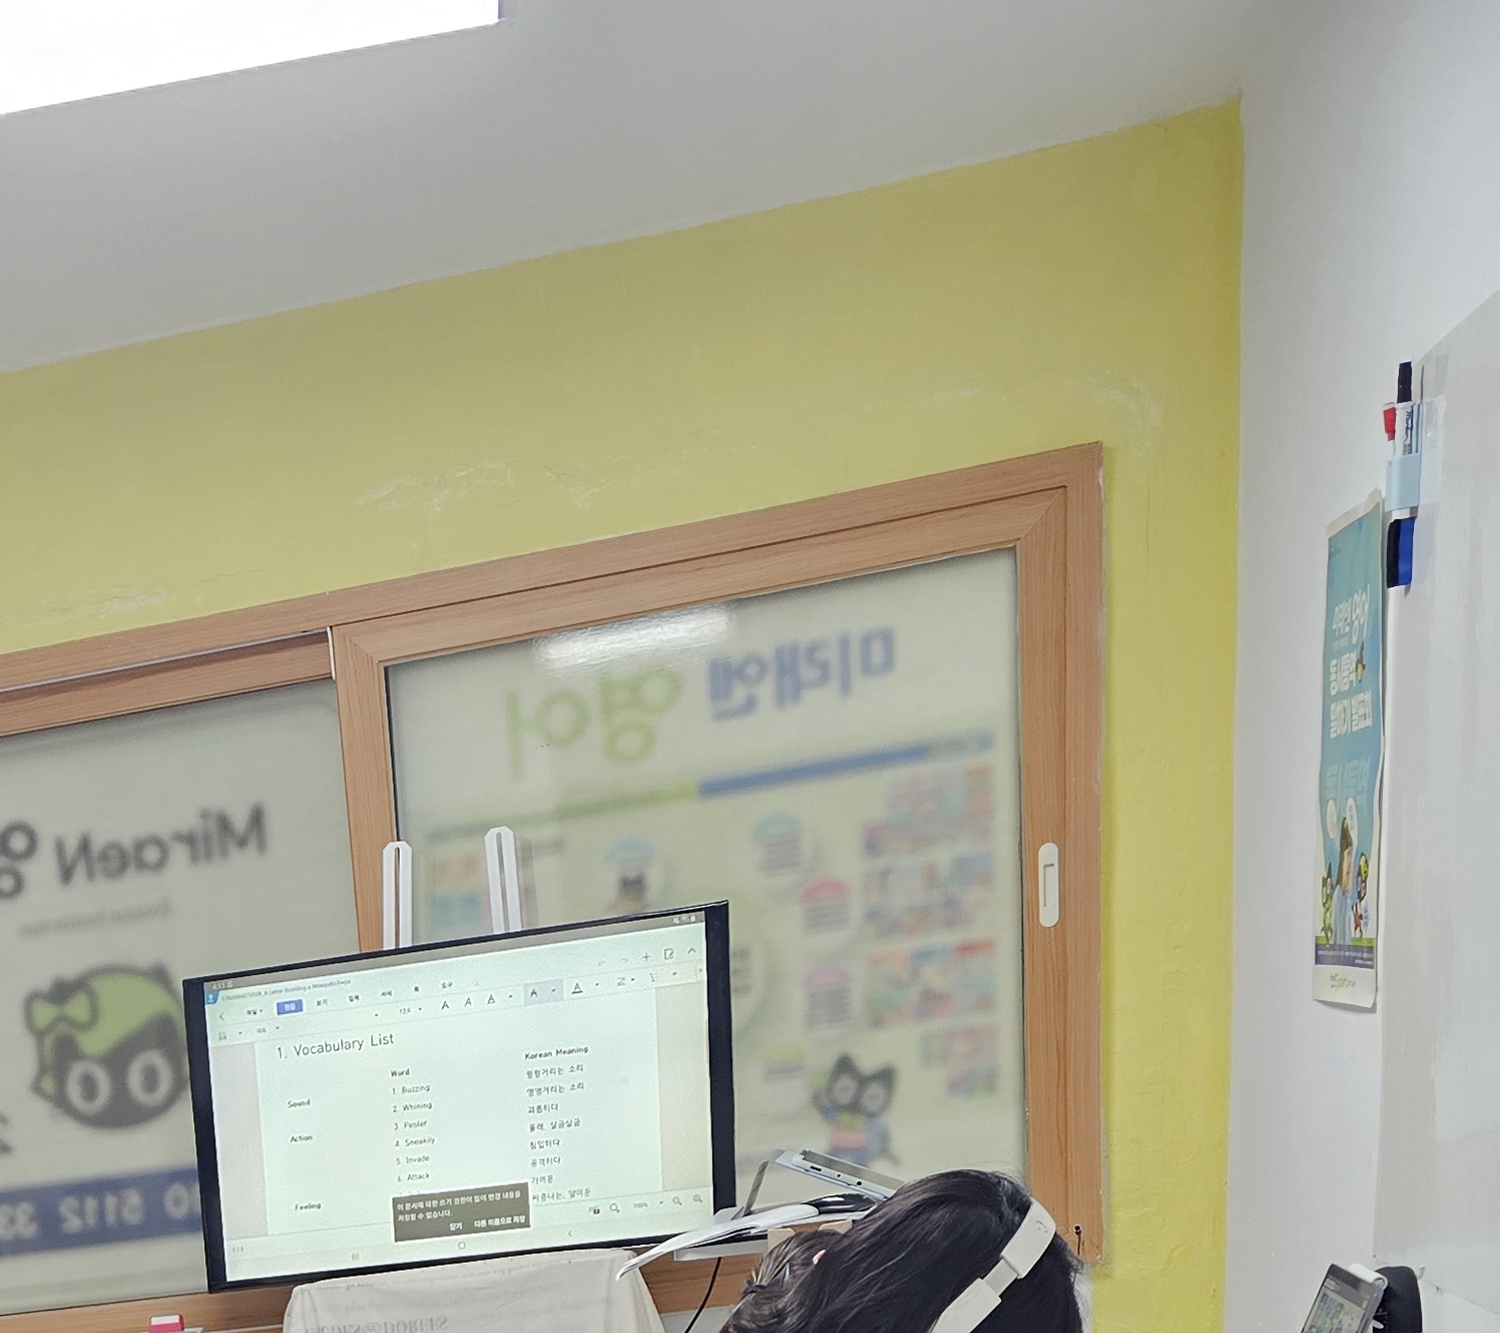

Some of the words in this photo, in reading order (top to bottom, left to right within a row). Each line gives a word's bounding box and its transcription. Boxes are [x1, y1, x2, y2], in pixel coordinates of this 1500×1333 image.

[277, 1047, 288, 1059] 1.
[293, 1038, 364, 1057] Vocabulary
[371, 1034, 394, 1047] List
[525, 1050, 553, 1060] Korean
[556, 1046, 589, 1056] Meaning
[390, 1068, 410, 1077] Word
[569, 1064, 584, 1072] 소리
[402, 1085, 430, 1094] Buzzing
[569, 1082, 584, 1091] 소리
[288, 1099, 311, 1108] Sound
[402, 1103, 432, 1112] Whining
[403, 1120, 427, 1129] Pester
[290, 1135, 313, 1143] Action
[405, 1137, 435, 1147] Sneakily
[406, 1155, 430, 1164] Invade
[531, 1156, 561, 1167] 공격하다
[407, 1172, 429, 1181] Attack
[531, 1174, 553, 1184] 가려운
[397, 1203, 404, 1211] 이
[405, 1201, 424, 1211] 문서에
[425, 1200, 438, 1208] 대한
[502, 1190, 521, 1199] 내용을
[294, 1203, 322, 1212] Feeling
[417, 1212, 424, 1220] 수
[425, 1209, 453, 1219] 없습니다.
[474, 1219, 487, 1228] 다른
[488, 1216, 512, 1226] 이름으로
